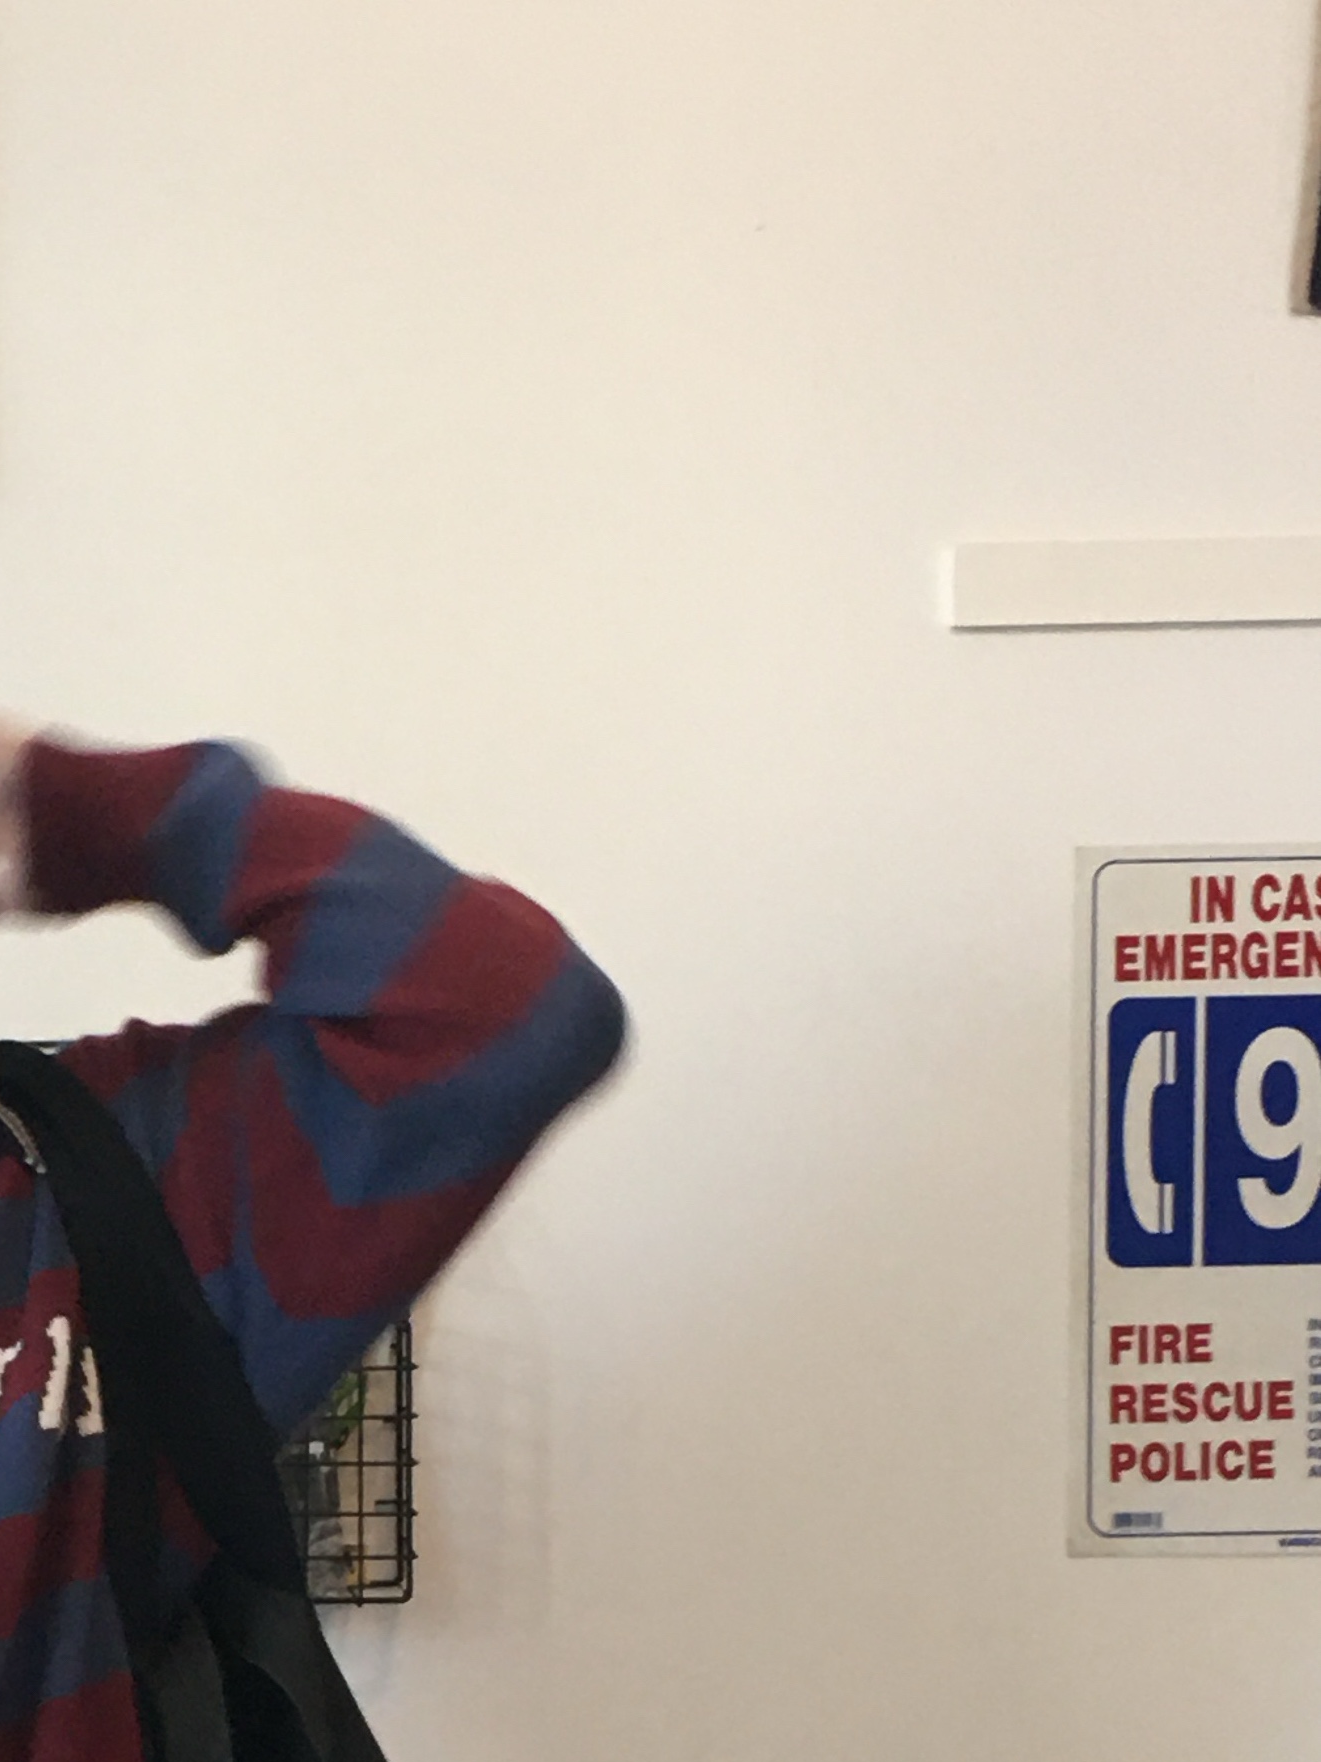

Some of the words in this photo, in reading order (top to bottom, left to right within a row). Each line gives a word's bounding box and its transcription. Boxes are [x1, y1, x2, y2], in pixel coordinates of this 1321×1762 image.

[1190, 875, 1235, 923] IN
[1252, 873, 1321, 922] CA
[1110, 1323, 1214, 1365] FIRE
[1110, 1380, 1295, 1425] RESCUE
[1110, 1439, 1277, 1483] POLICE
